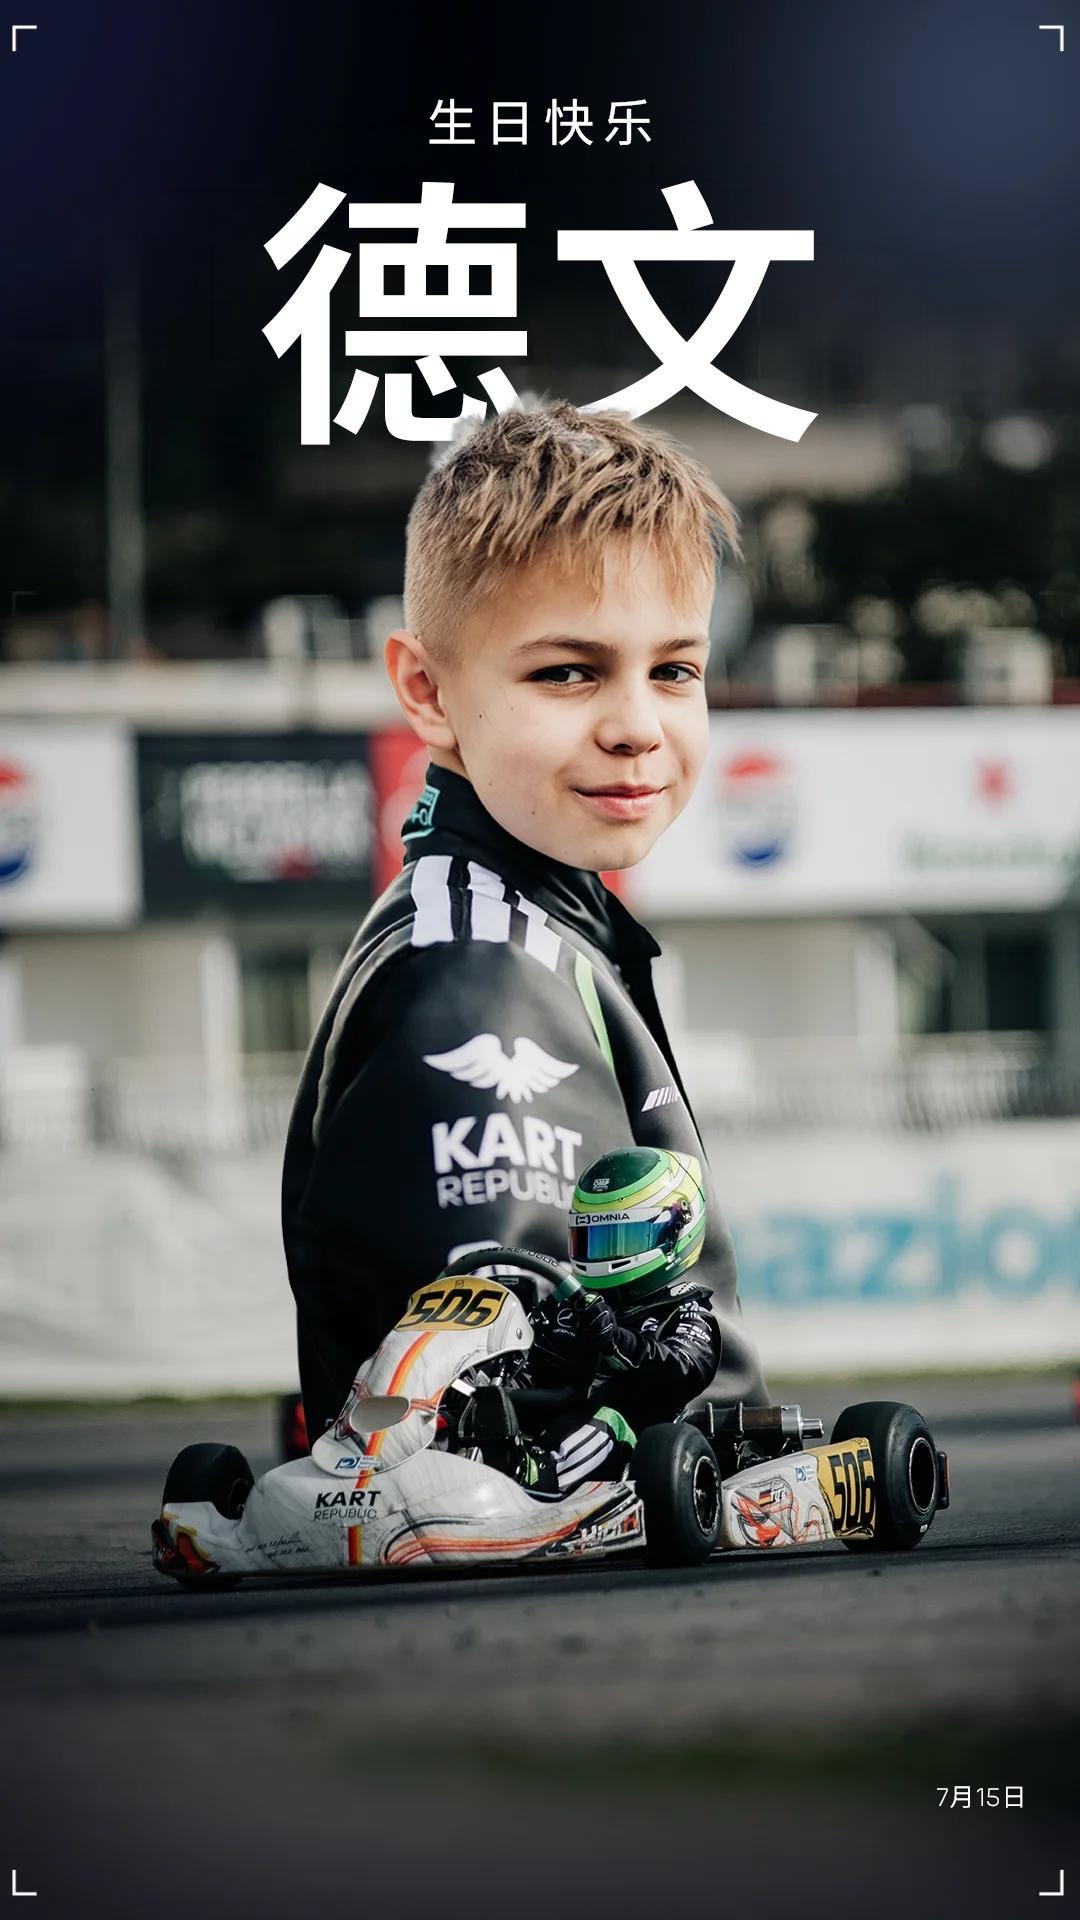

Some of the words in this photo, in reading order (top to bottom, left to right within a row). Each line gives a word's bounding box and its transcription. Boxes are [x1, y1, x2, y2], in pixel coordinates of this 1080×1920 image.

[432, 1112, 583, 1181] KART
[436, 1168, 576, 1210] REPUBLI
[591, 1213, 630, 1223] OMNIA
[397, 1287, 504, 1327] 506
[315, 1489, 381, 1509] KART
[828, 1447, 876, 1534] 506
[313, 1507, 378, 1522] REPUBLIC
